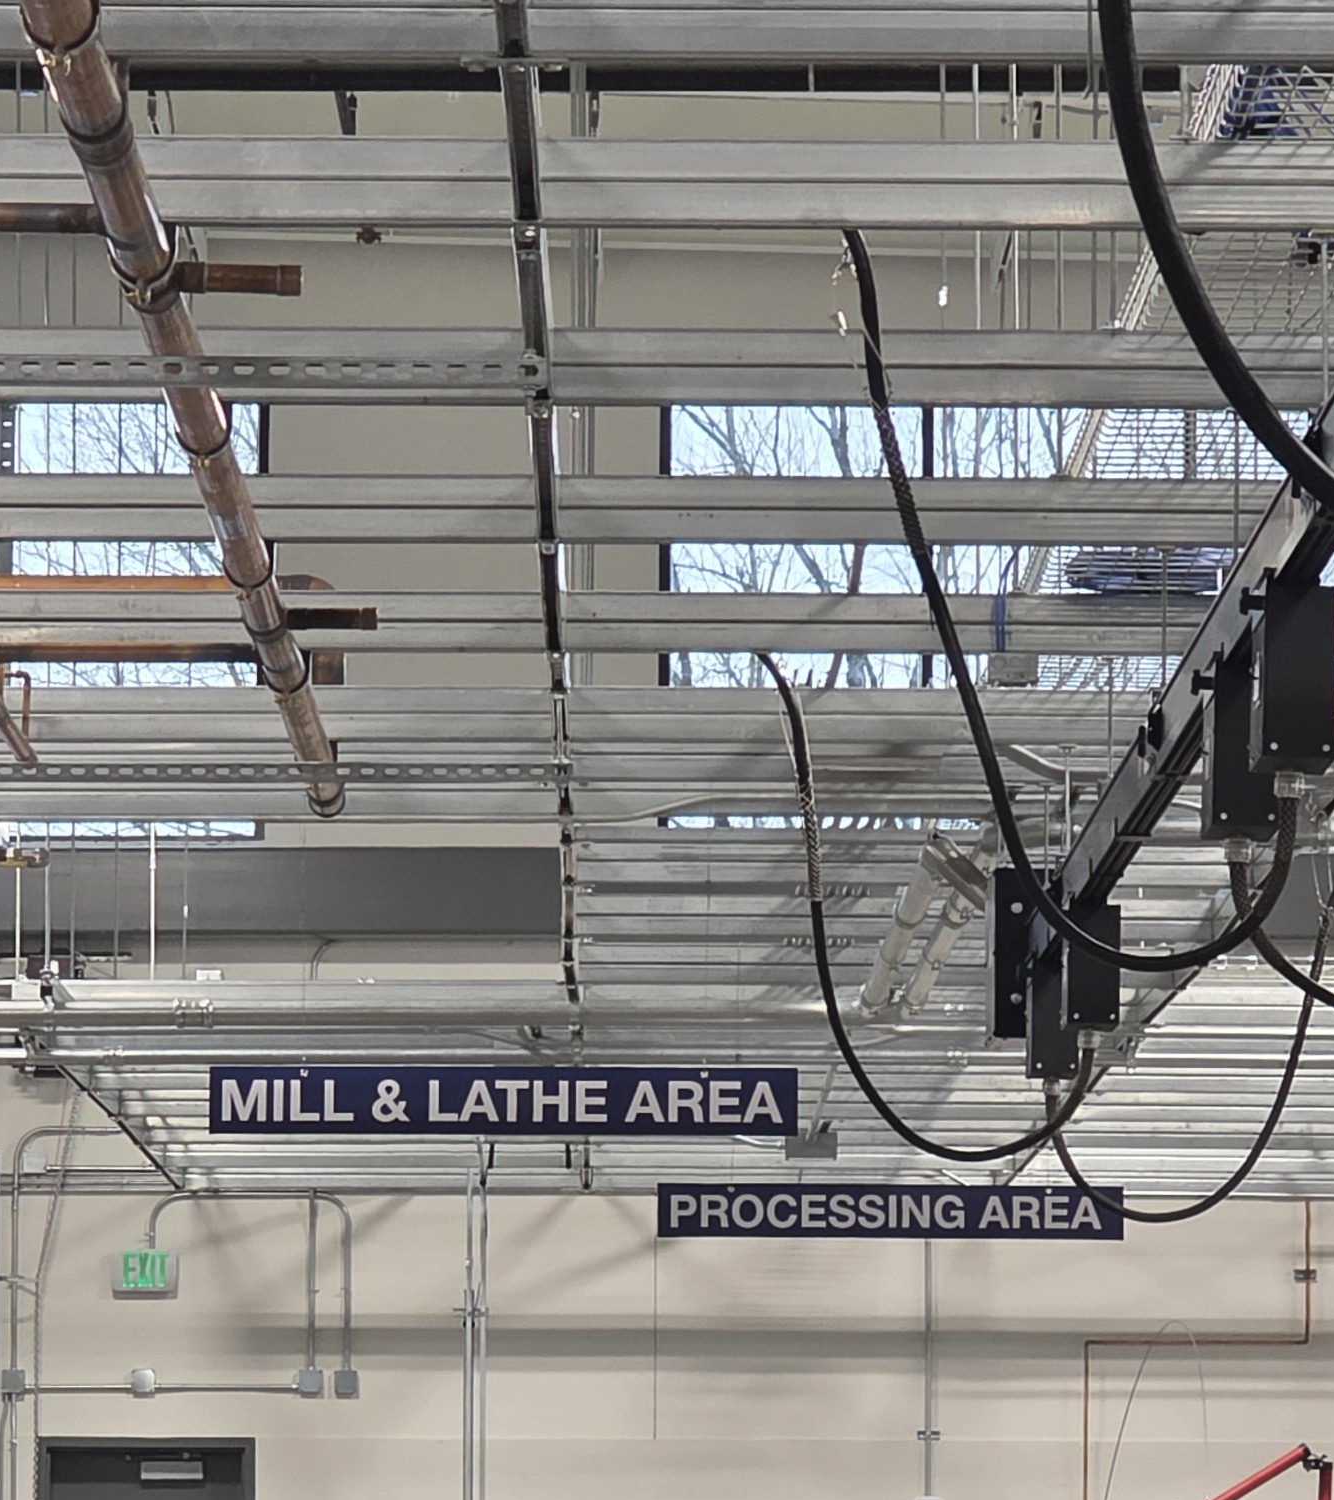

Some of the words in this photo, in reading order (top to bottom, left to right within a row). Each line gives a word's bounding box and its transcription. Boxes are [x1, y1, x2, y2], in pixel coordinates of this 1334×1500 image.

[220, 1079, 355, 1122] MILL
[371, 1078, 411, 1123] &
[427, 1079, 609, 1123] LATHE
[624, 1080, 784, 1124] AREA
[669, 1193, 965, 1229] PROCESSING
[978, 1195, 1102, 1230] AREA
[122, 1252, 170, 1288] EXIT
